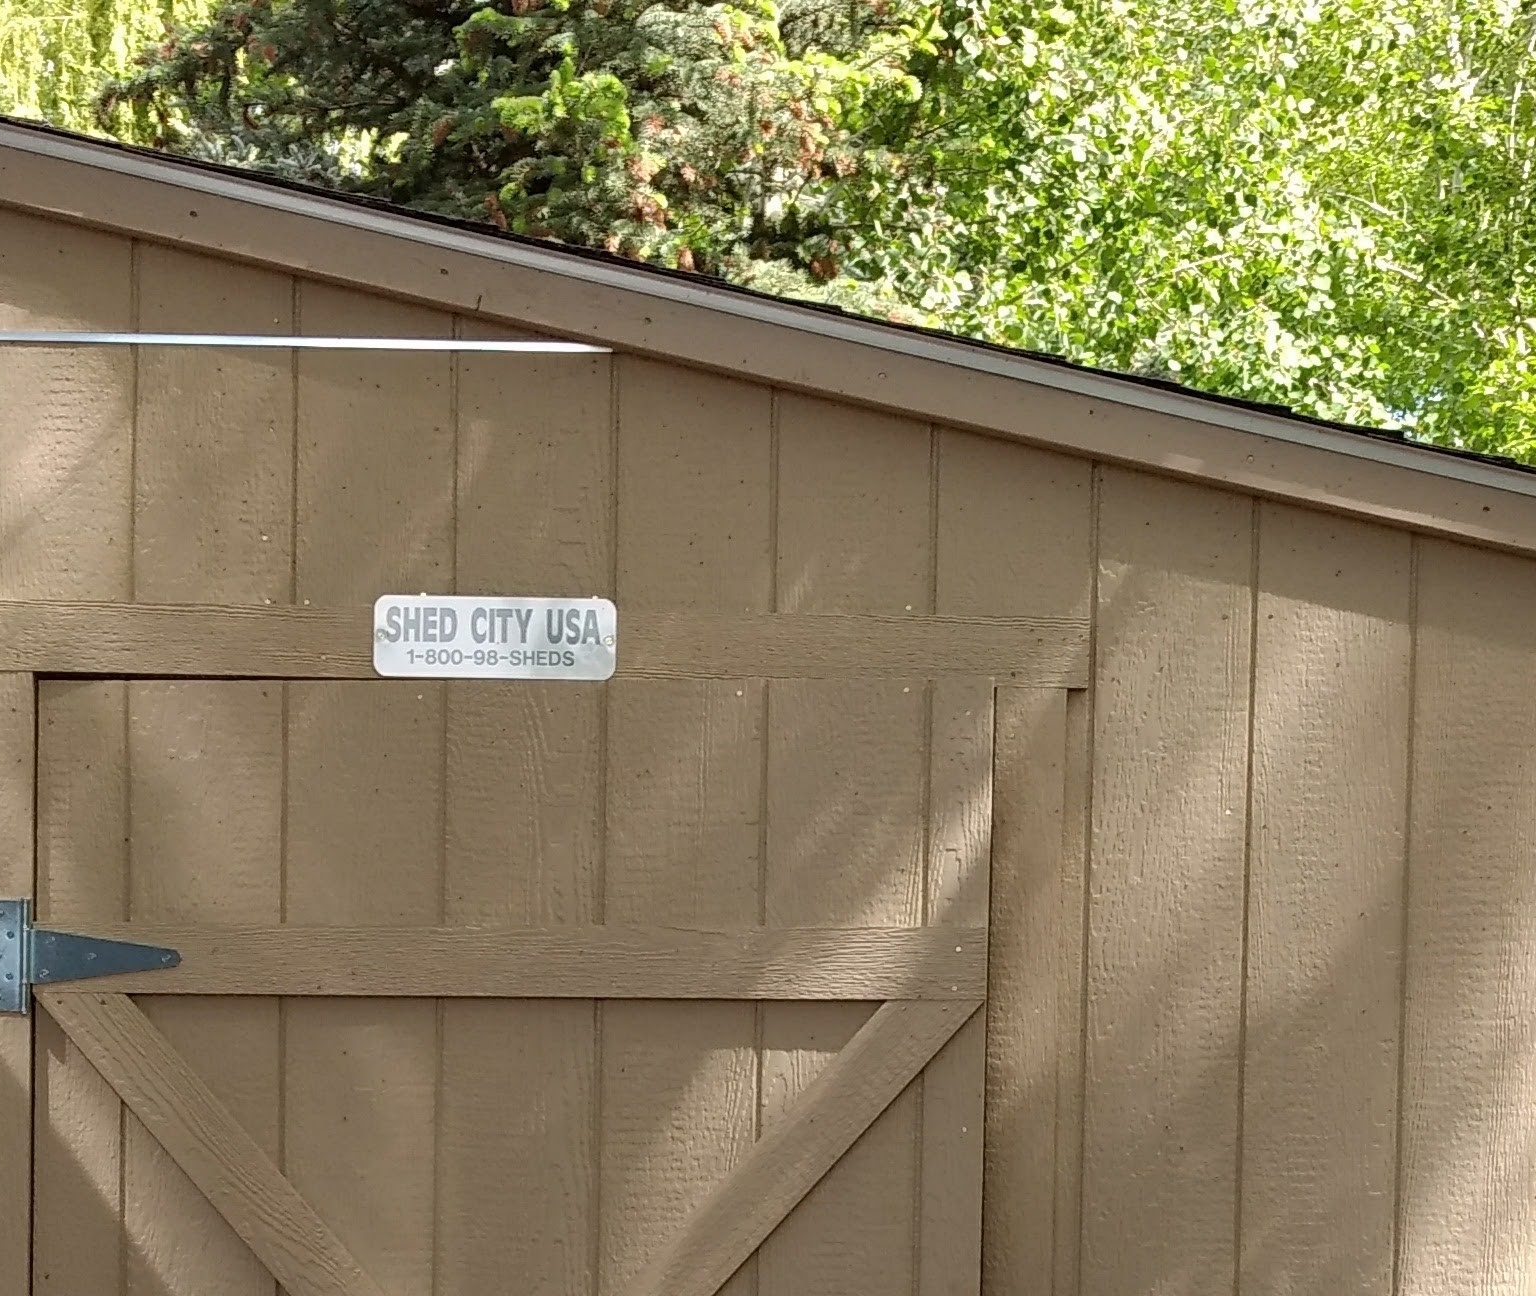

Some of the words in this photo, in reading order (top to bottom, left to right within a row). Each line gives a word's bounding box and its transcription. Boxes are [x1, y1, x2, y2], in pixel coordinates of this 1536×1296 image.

[386, 606, 458, 643] SHED
[470, 607, 534, 645] CITY
[546, 608, 601, 646] USA
[407, 649, 575, 667] 1-800-98-SHEDS
